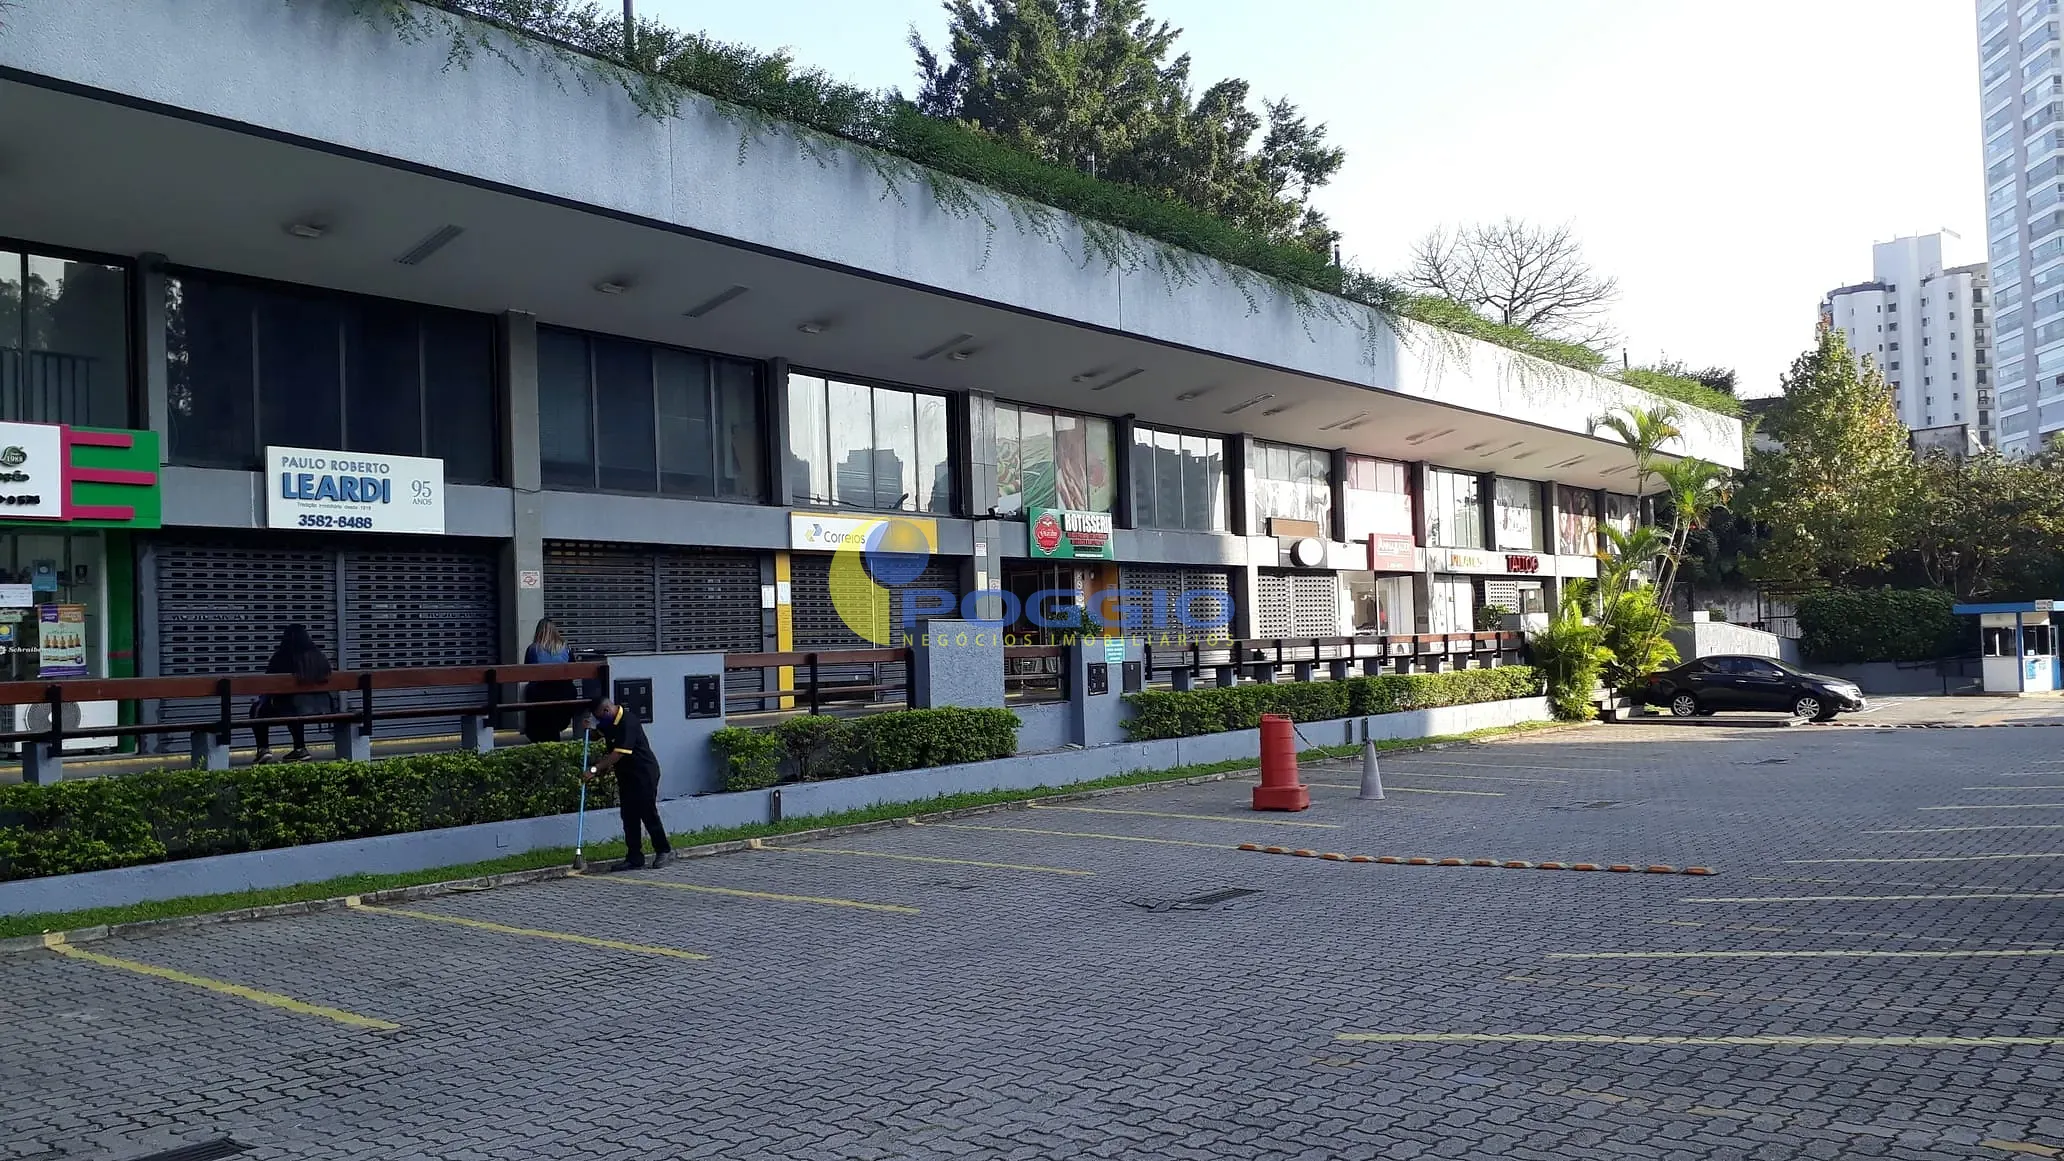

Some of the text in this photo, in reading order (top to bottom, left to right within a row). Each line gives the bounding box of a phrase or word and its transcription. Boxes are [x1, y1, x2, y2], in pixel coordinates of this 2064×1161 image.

[282, 457, 390, 474] PAULO ROBERTO
[282, 472, 391, 504] LEARDI
[411, 480, 432, 498] 95
[824, 531, 866, 544] Correios
